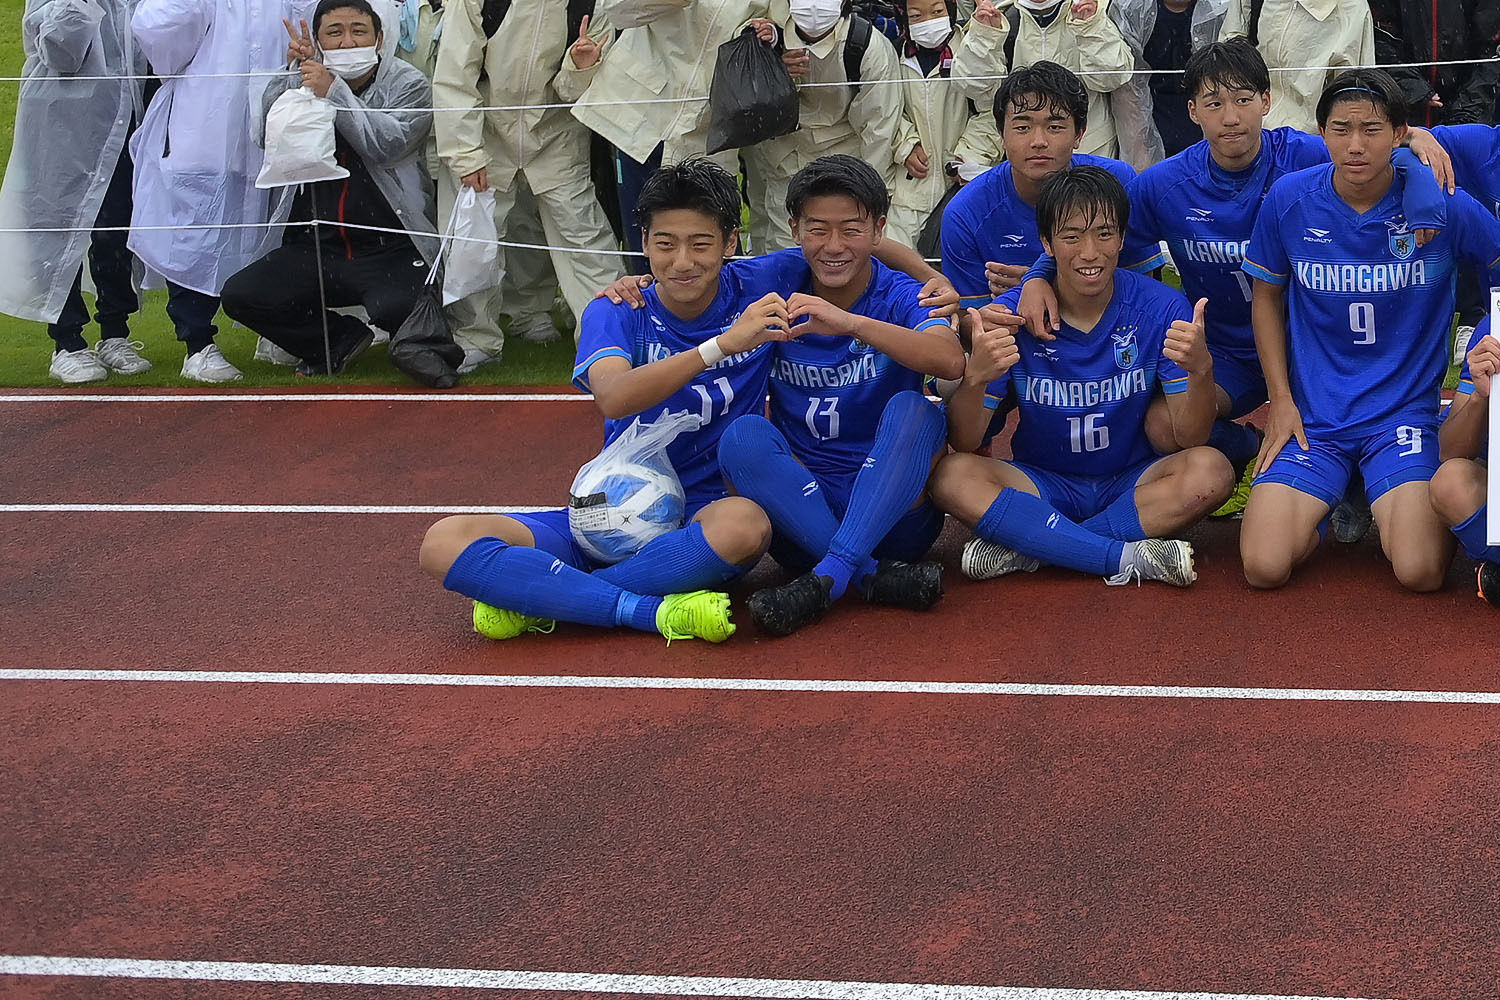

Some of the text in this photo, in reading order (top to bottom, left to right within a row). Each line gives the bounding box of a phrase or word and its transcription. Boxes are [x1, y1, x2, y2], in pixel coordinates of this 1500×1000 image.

[1303, 236, 1333, 244] PENALTY
[1297, 260, 1426, 293] KANAGAWA
[1348, 302, 1376, 345] 9
[770, 353, 877, 388] KANAGAWA
[1025, 368, 1147, 407] KANAGAWA
[691, 376, 734, 426] 11
[805, 396, 840, 441] 13
[1066, 412, 1110, 454] 16
[1396, 425, 1422, 458] 9
